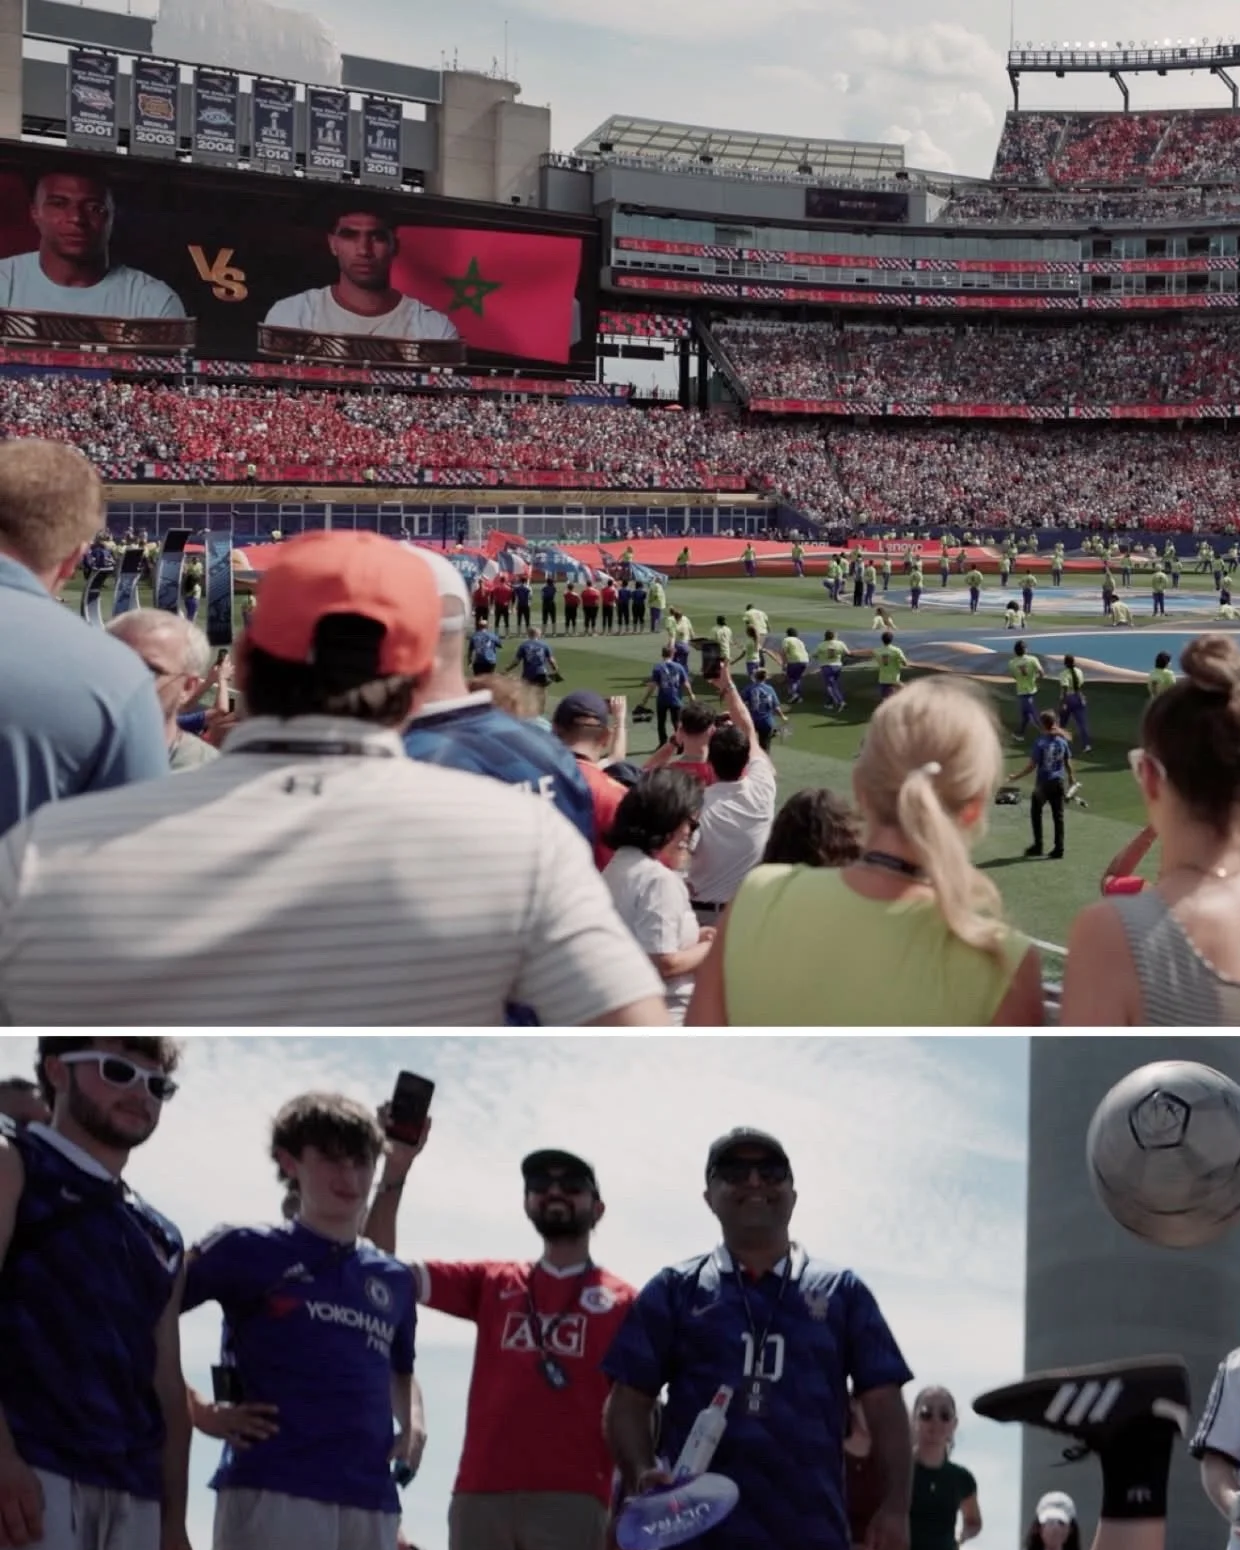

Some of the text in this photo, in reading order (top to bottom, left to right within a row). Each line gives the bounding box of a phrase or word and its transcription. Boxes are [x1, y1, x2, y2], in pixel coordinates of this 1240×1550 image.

[74, 122, 112, 136] 2001
[136, 131, 175, 145] 2003
[197, 140, 234, 153] 2004
[257, 148, 289, 160] 2014
[313, 156, 345, 168] 2016
[367, 163, 397, 175] 2018
[187, 245, 248, 302] VS
[741, 1332, 785, 1382] 10
[642, 1502, 713, 1535] ULTRA
